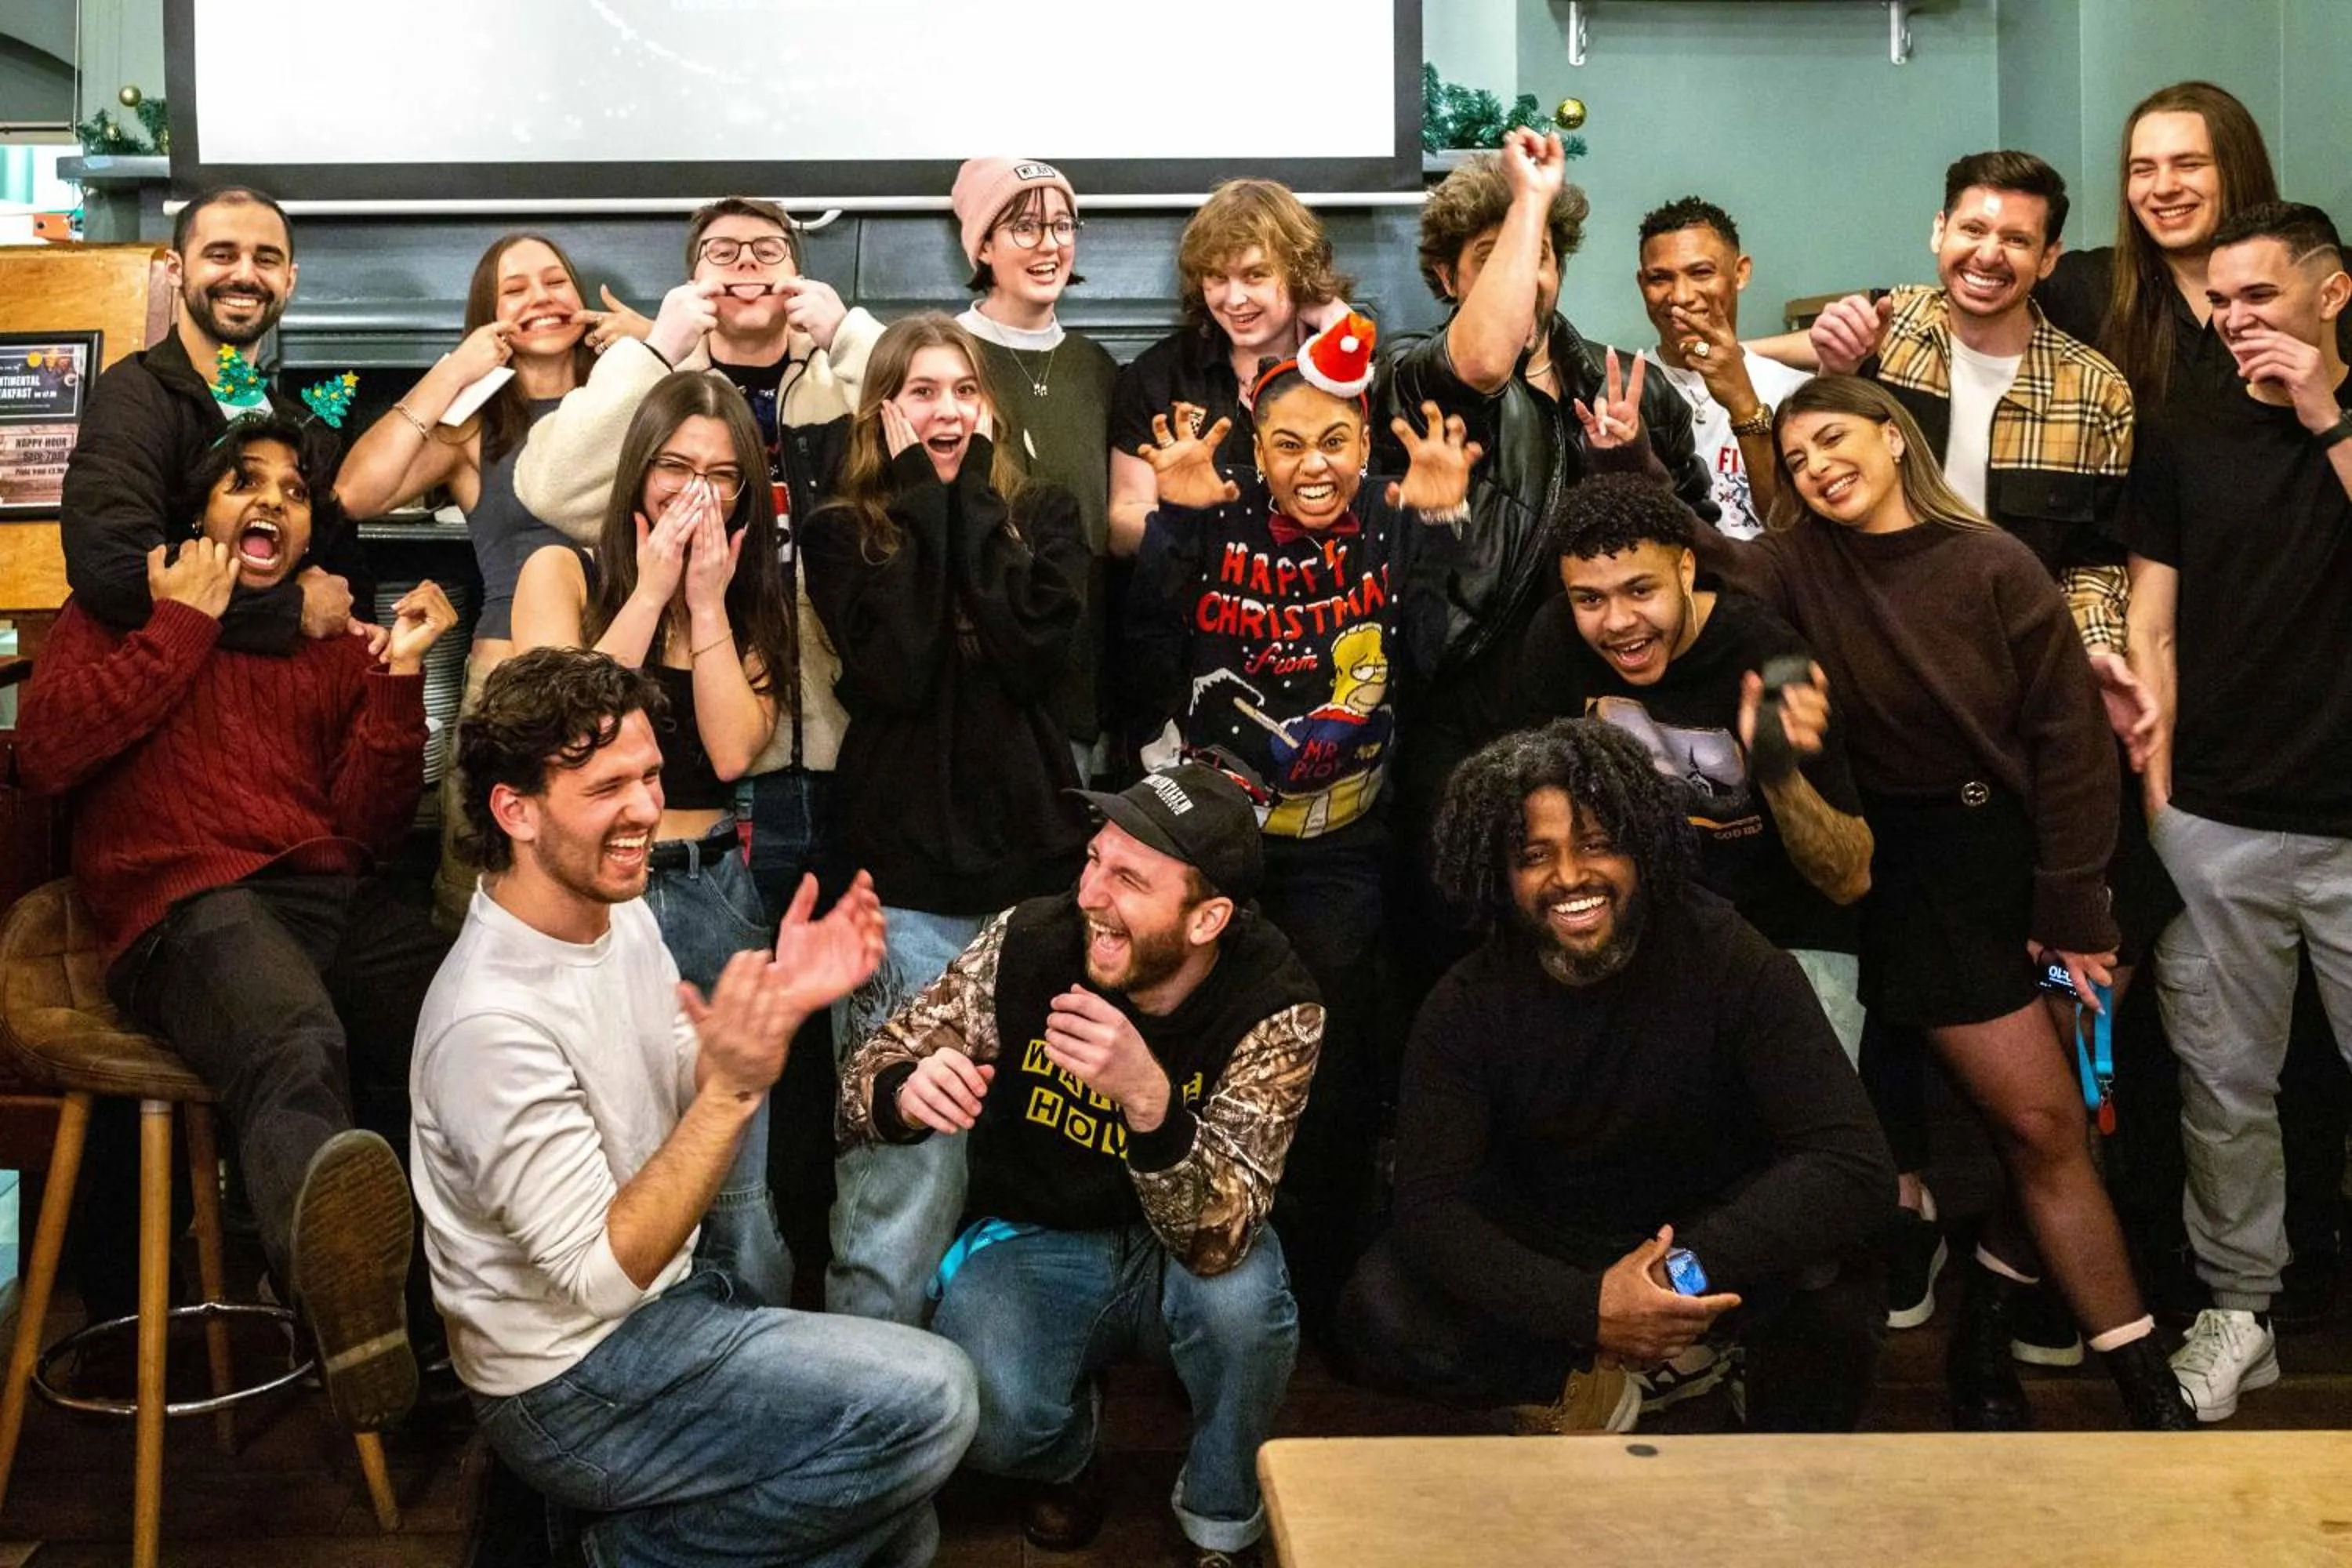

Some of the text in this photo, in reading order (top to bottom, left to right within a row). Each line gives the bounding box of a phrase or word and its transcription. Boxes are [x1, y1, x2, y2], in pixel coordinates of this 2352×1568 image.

[0, 387, 32, 399] AKFAST
[1196, 562, 1388, 641] CHRISTMA
[1243, 642, 1318, 675] from
[1302, 737, 1338, 762] MR
